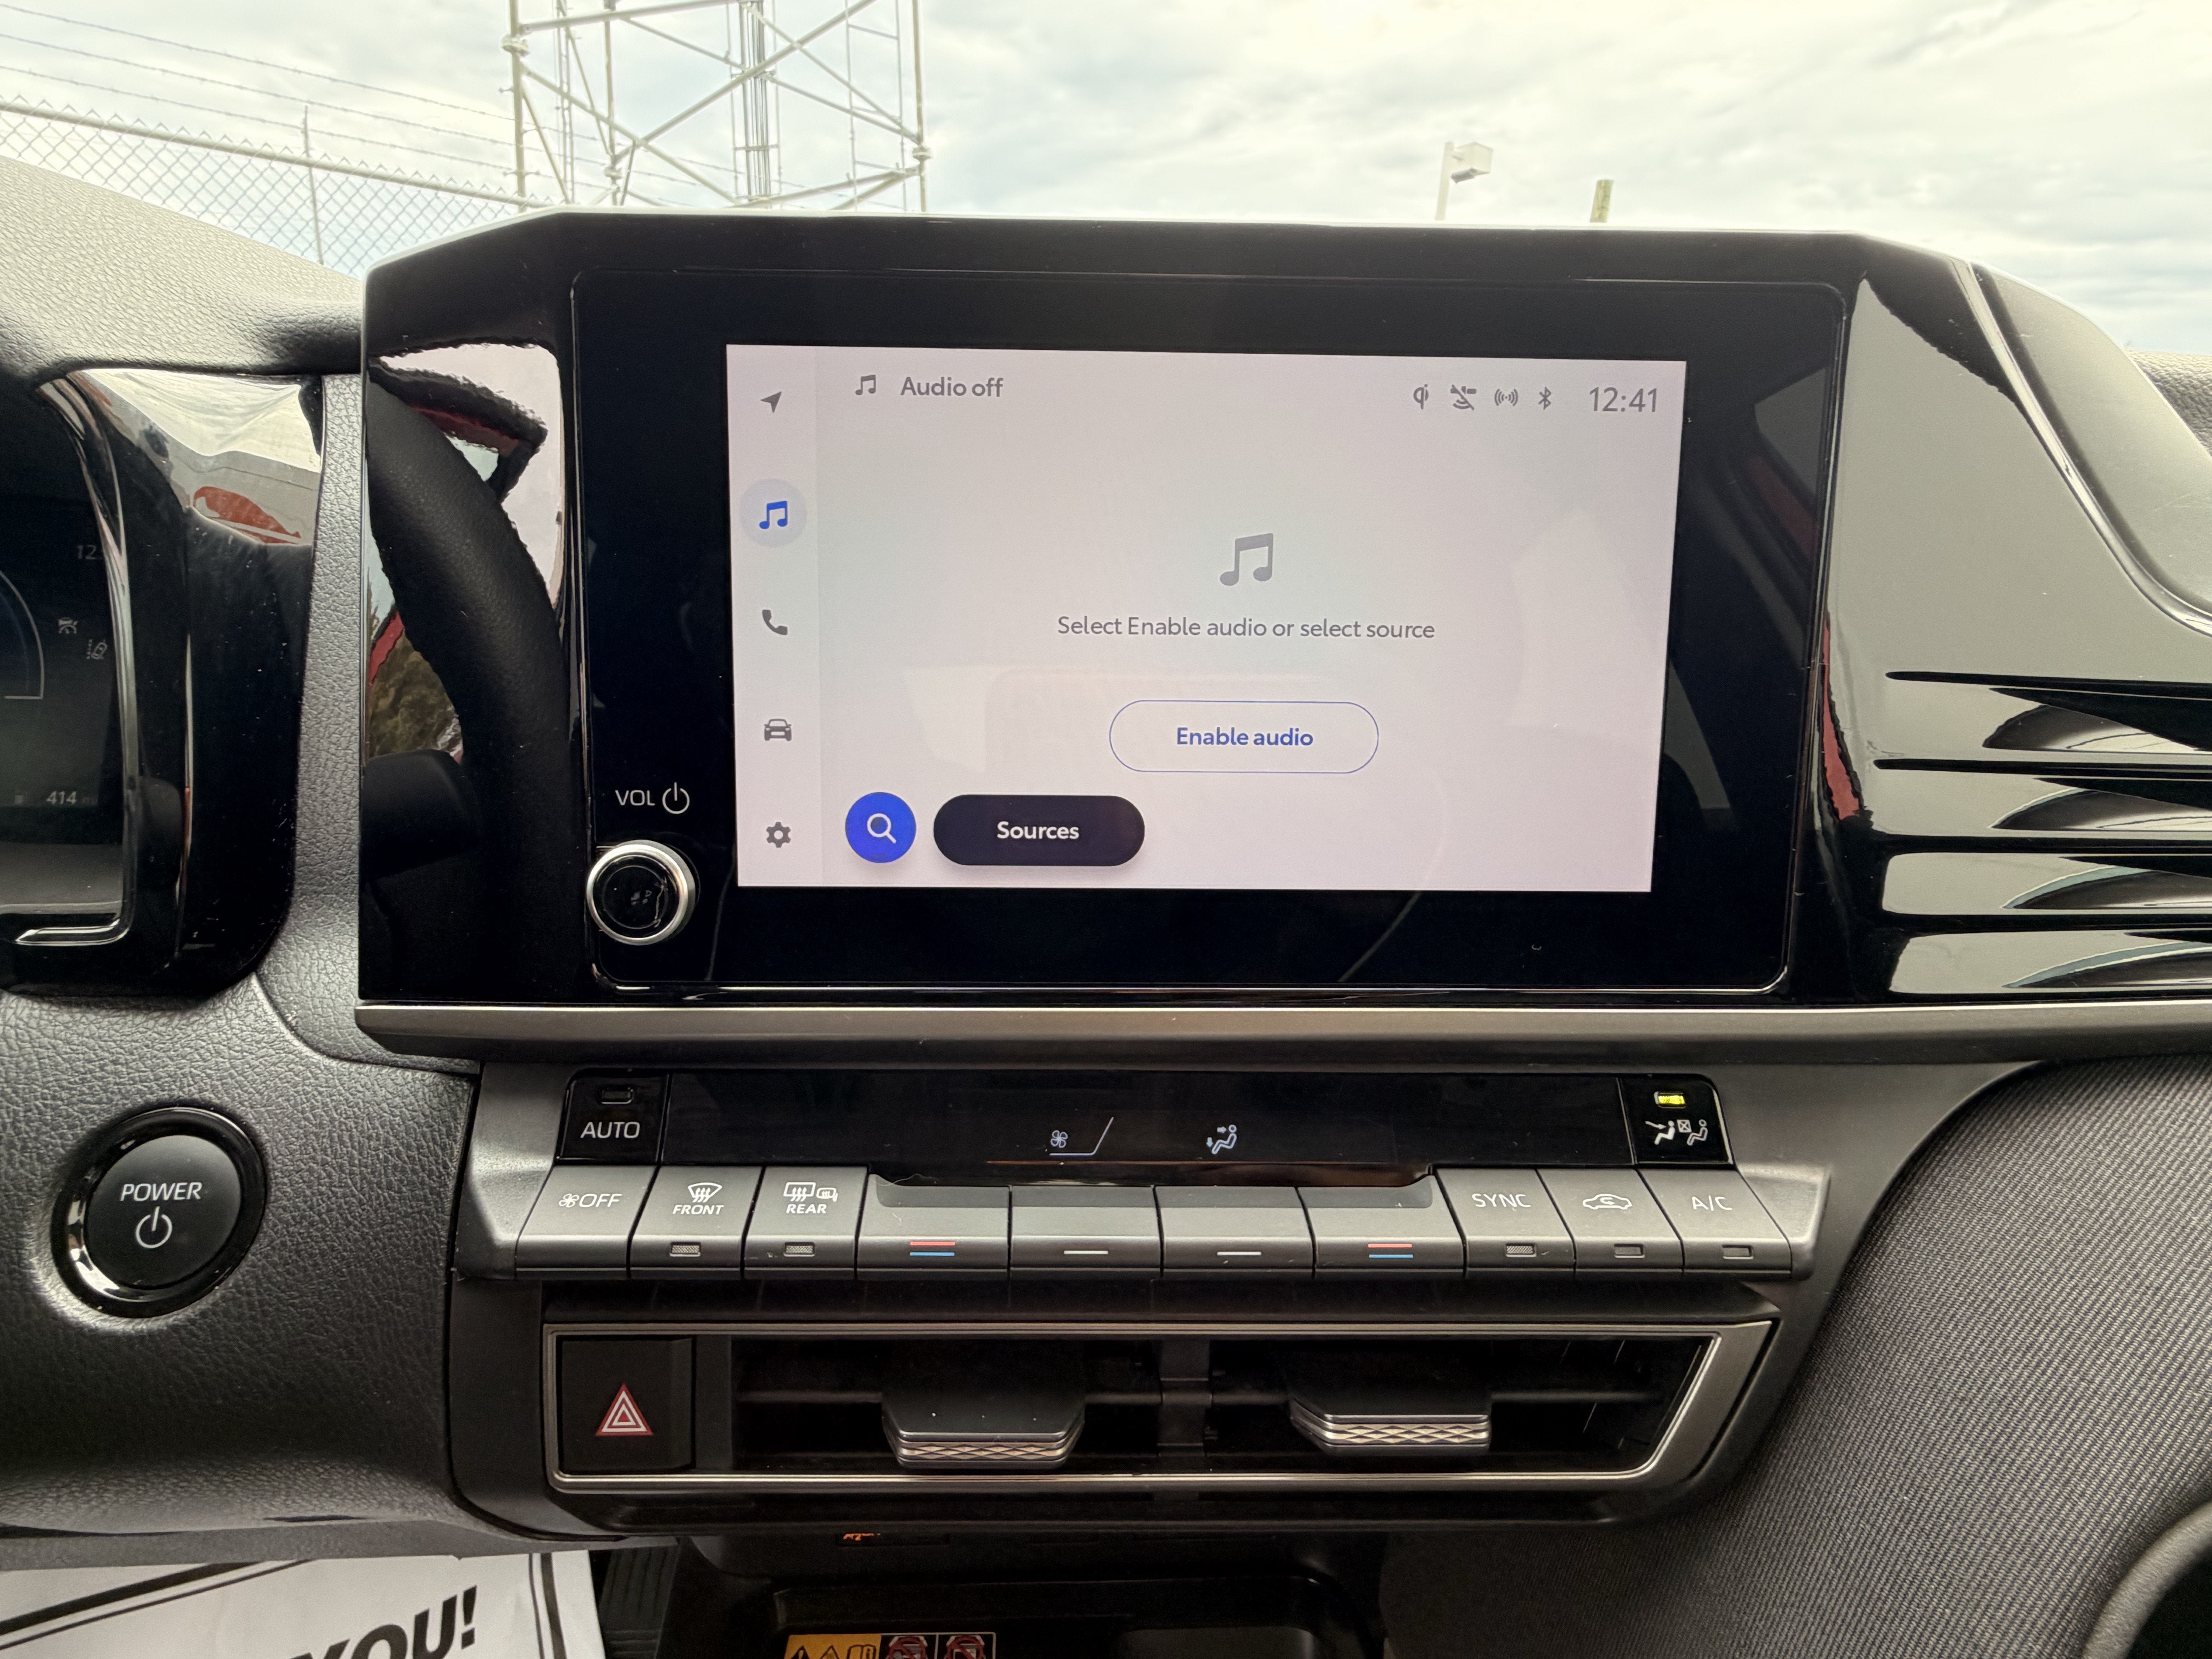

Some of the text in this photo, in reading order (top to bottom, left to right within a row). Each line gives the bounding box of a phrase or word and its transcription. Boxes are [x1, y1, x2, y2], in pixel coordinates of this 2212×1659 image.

[900, 376, 1004, 397] Audio off
[1589, 386, 1657, 412] 12:41
[1058, 615, 1435, 638] Select Enable audio or select source
[1177, 726, 1314, 746] Enable audio
[46, 791, 77, 805] 414
[615, 790, 655, 806] VOL
[997, 821, 1079, 840] Sources
[580, 1121, 640, 1139] AUTO
[120, 1182, 202, 1201] POWER
[579, 1193, 622, 1207] OFF
[785, 1203, 827, 1214] REAR
[1472, 1193, 1531, 1208] SYNC
[1692, 1195, 1733, 1211] A/C
[672, 1204, 724, 1215] FRONT
